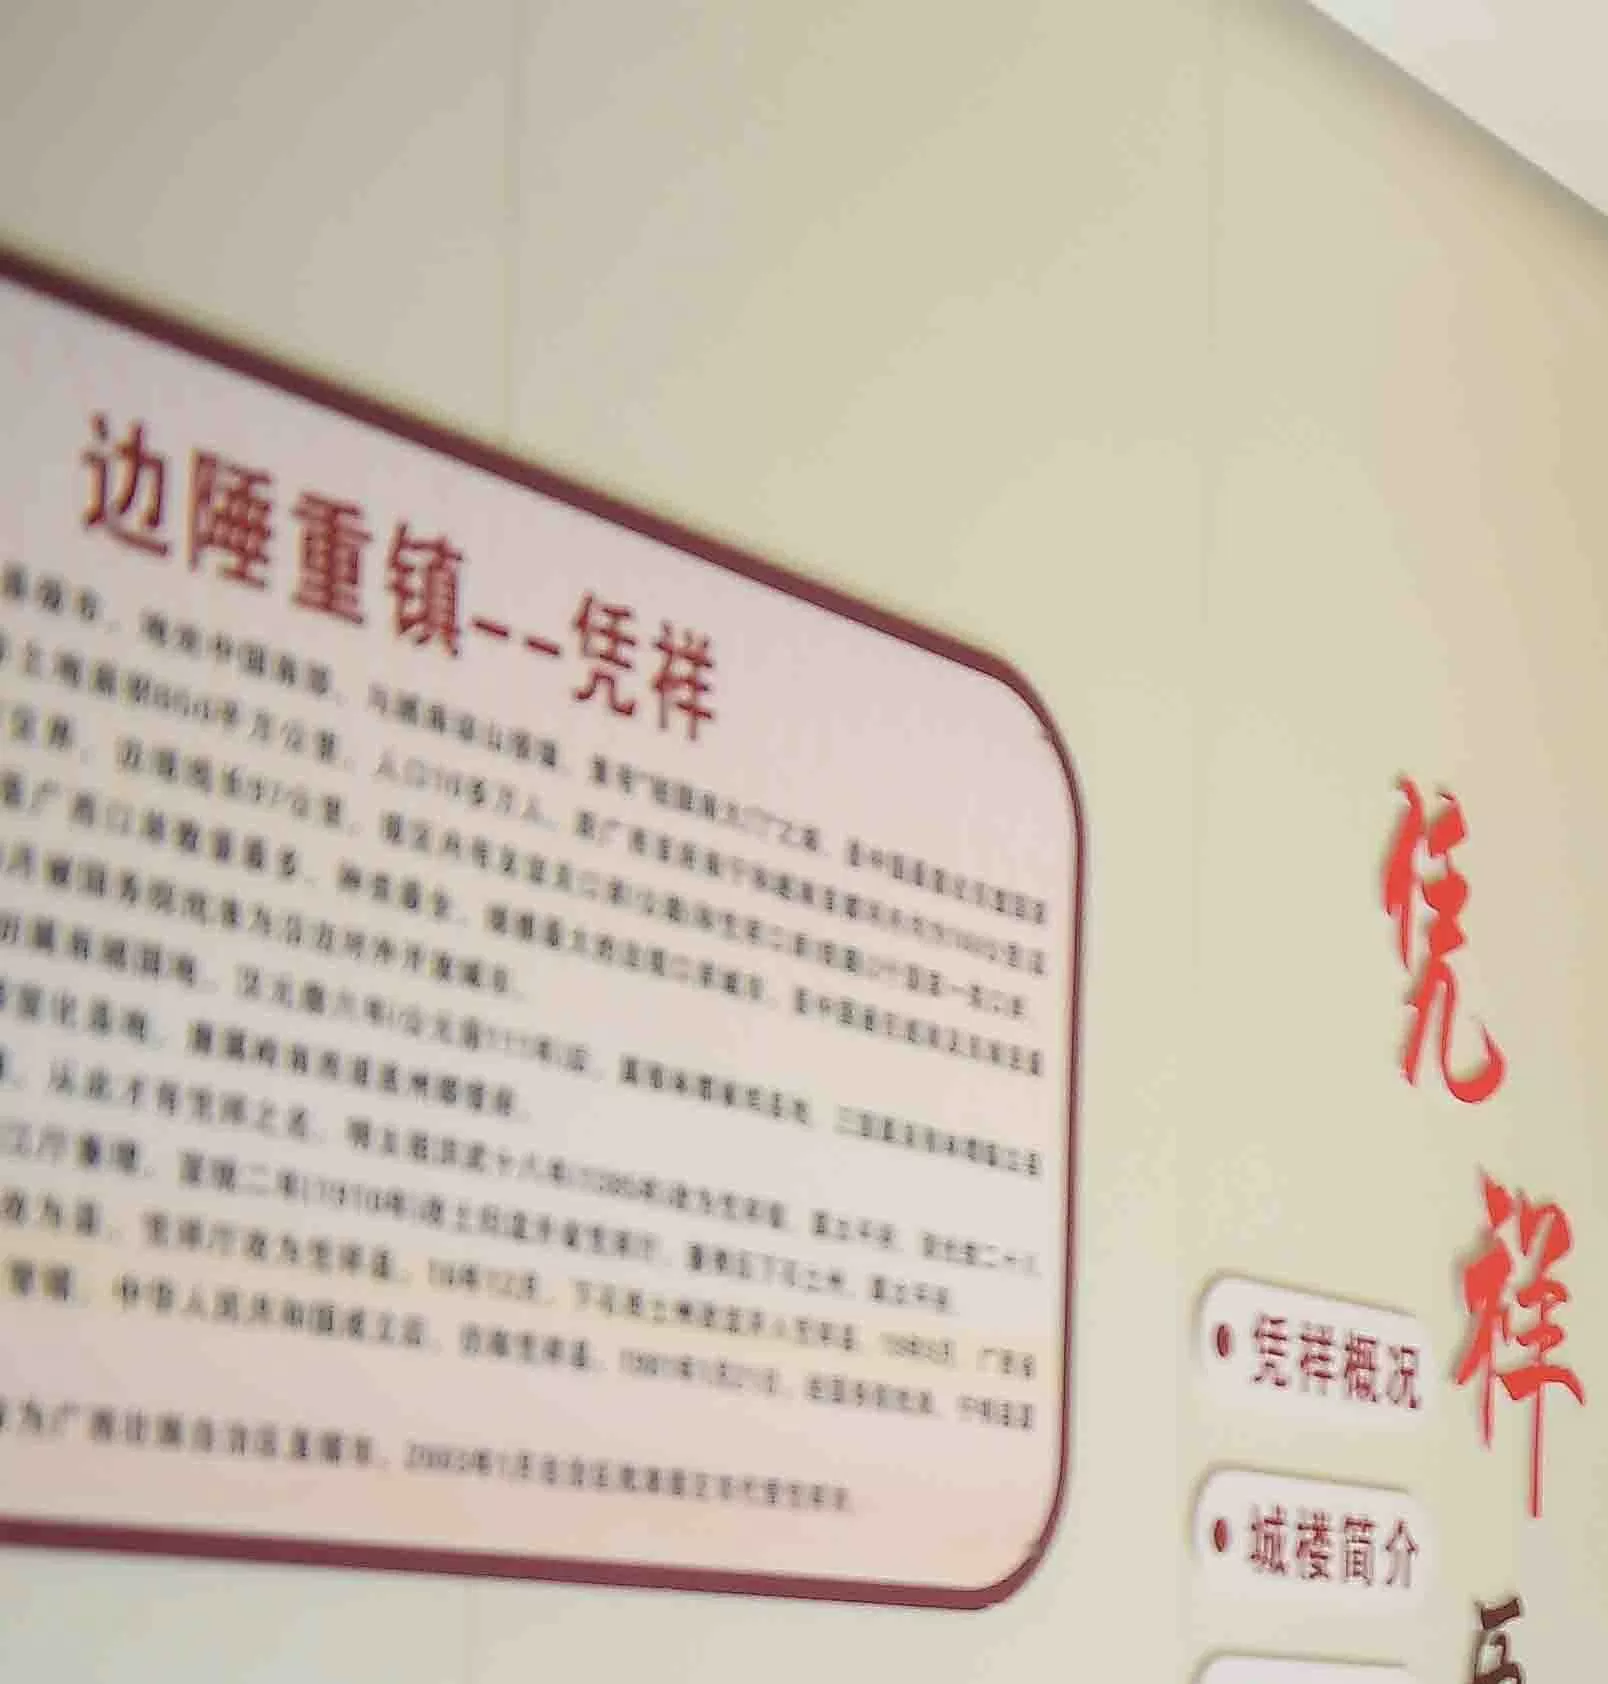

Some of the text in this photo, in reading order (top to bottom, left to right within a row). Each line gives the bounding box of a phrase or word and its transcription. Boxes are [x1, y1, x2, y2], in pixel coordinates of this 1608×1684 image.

[1250, 1311, 1423, 1411] 凭祥概况
[1248, 1504, 1420, 1588] 城楼简介
